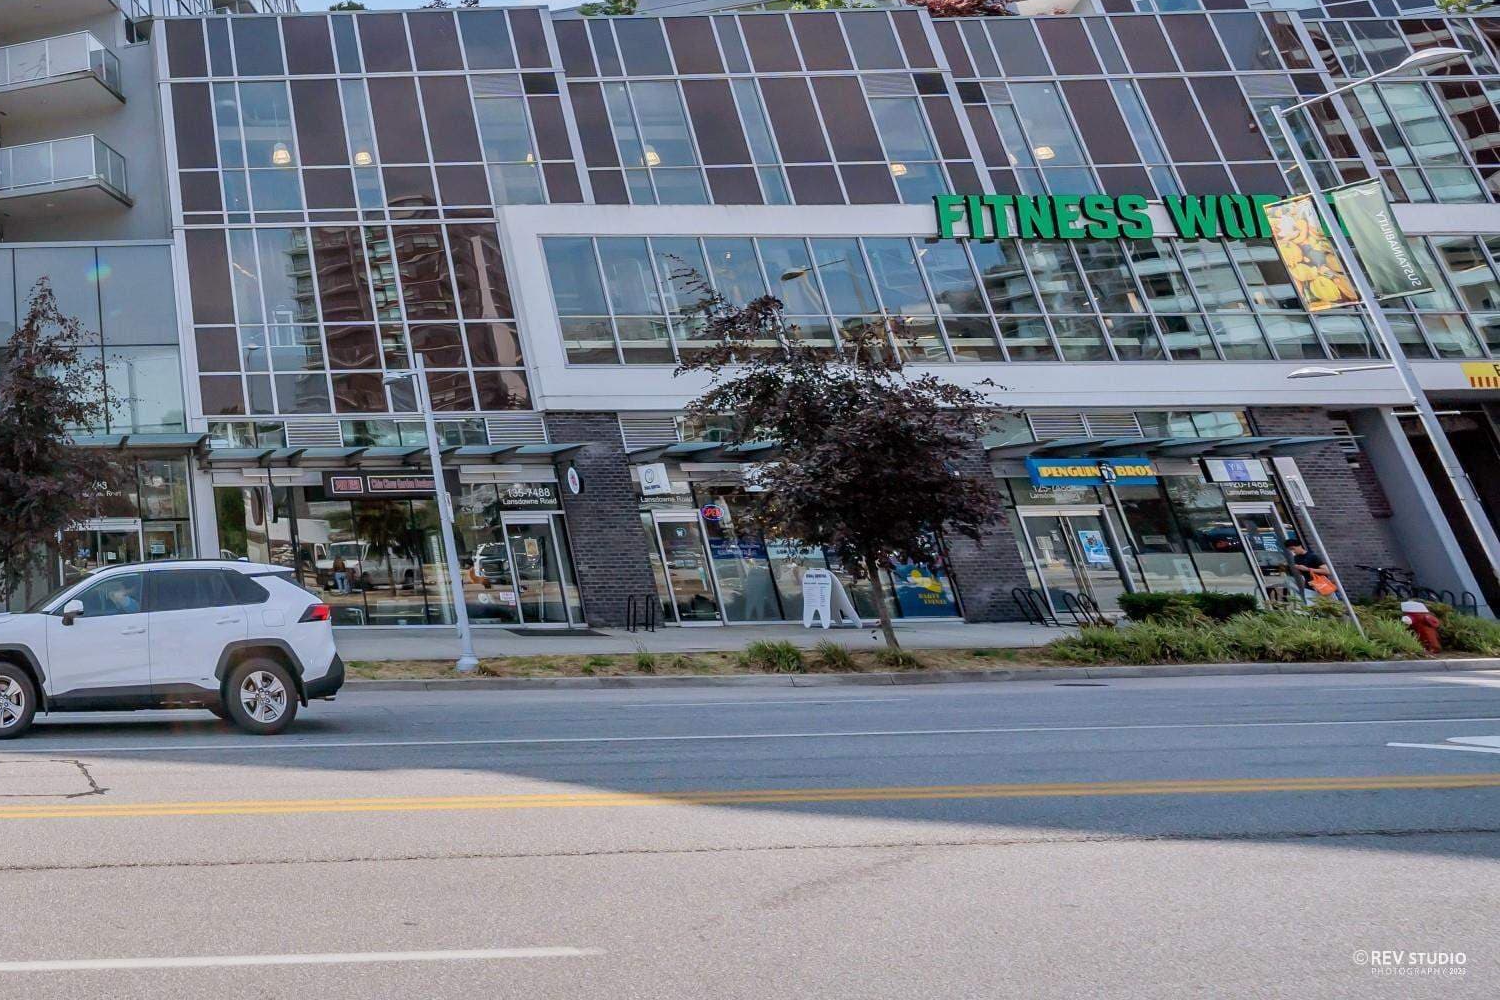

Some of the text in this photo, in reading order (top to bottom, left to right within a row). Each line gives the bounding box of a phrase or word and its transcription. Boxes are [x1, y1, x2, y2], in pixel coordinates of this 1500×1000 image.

[933, 194, 1154, 239] FITNESS
[1038, 465, 1101, 477] PENGUIN
[507, 487, 551, 498] 135-7488
[502, 497, 557, 505] Lansdowne Road
